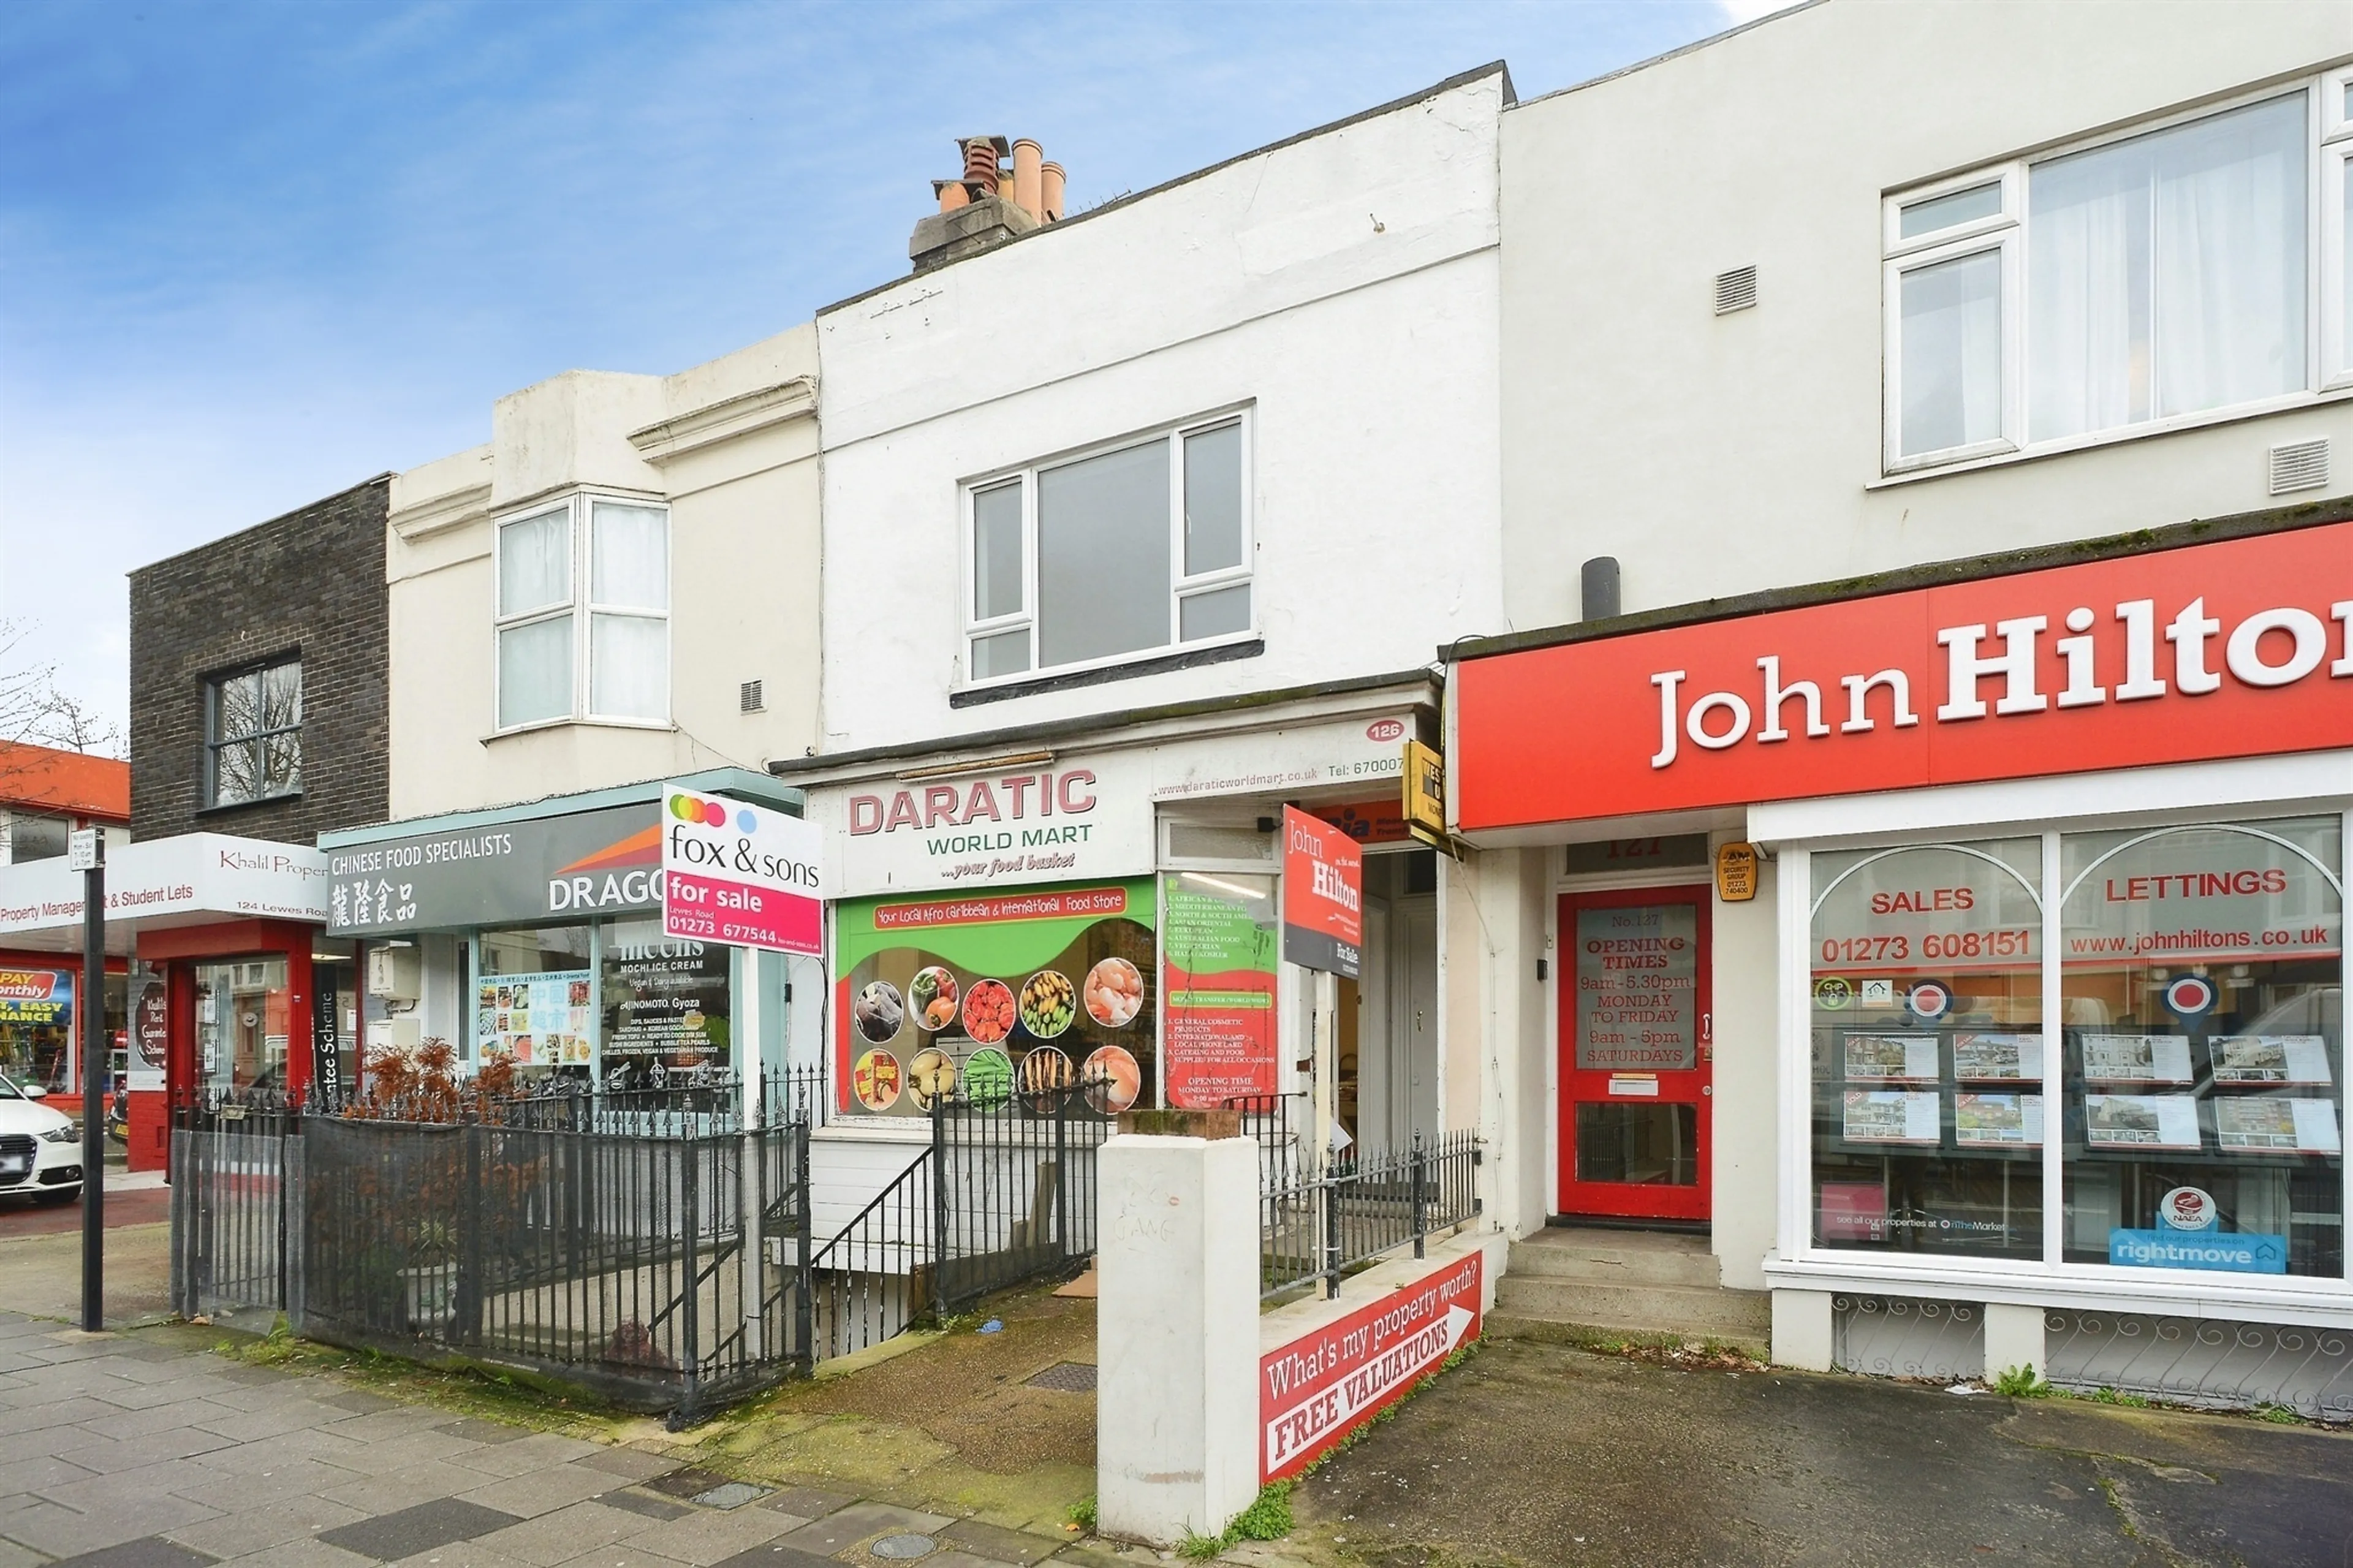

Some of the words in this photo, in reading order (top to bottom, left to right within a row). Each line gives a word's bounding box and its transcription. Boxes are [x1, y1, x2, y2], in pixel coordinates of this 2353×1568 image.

[1651, 656, 1919, 769] John
[1371, 724, 1400, 739] 126
[1328, 765, 1350, 777] Tel:
[1354, 757, 1404, 775] 670007
[849, 769, 1097, 836] DARATIC
[927, 832, 1012, 856] WORLD
[1022, 824, 1093, 848] MART
[1289, 819, 1323, 858] John
[220, 850, 268, 870] Khalil
[274, 855, 328, 881] Proper
[332, 851, 382, 876] CHINESE
[386, 846, 422, 869] FOOD
[426, 833, 512, 864] SPECIALISTS
[669, 825, 727, 868] fox
[735, 838, 757, 874] &
[763, 855, 819, 888] sons
[987, 854, 1023, 877] food
[1026, 852, 1076, 871] basket
[670, 876, 709, 904] for
[716, 888, 763, 912] sale
[1312, 860, 1358, 912] Hilton
[2106, 869, 2286, 902] LETTINGS
[1, 905, 39, 923] Property
[111, 894, 119, 907] &
[122, 888, 164, 906] Student
[168, 884, 193, 900] Lets
[237, 901, 257, 910] 124
[263, 904, 302, 915] Lewes
[306, 907, 328, 917] Roa
[669, 906, 692, 917] Lewes
[695, 909, 714, 918] Road
[877, 911, 898, 924] Your
[900, 908, 922, 923] Local
[924, 909, 943, 923] Afro
[946, 903, 990, 919] Caribbean
[993, 906, 999, 917] &
[1001, 898, 1061, 915] International
[1066, 895, 1090, 911] Food
[1093, 895, 1122, 909] Store
[1871, 888, 1974, 914] SALES
[669, 916, 715, 934] 01273
[723, 923, 776, 944] 677544
[1586, 937, 1685, 954] OPENING
[1822, 936, 1909, 963] 01273
[1922, 930, 2029, 959] 608151
[620, 964, 650, 974] MOCHI
[653, 962, 667, 972] ICE
[670, 960, 703, 971] CREAM
[1603, 955, 1668, 970] TIMES
[0, 973, 34, 984] PAY
[0, 985, 47, 998] onthly
[1597, 994, 1673, 1008] MONDAY
[20, 1002, 63, 1012] EASY
[672, 998, 700, 1010] Gyoza
[0, 1012, 53, 1022] NANCE
[1591, 1012, 1614, 1023] TO
[1619, 1010, 1680, 1023] FRIDAY
[1590, 1031, 1626, 1043] 9am
[1641, 1029, 1681, 1046] 5pm
[1587, 1049, 1683, 1062] SATURDAYS
[1854, 1215, 1863, 1224] all
[1881, 1218, 1927, 1232] properties
[2183, 1235, 2232, 1246] properties
[2117, 1241, 2253, 1263] rightmove
[1267, 1337, 1337, 1401] What's
[1343, 1325, 1370, 1361] my
[1373, 1289, 1437, 1351] property
[1440, 1260, 1477, 1303] worth?
[1275, 1388, 1338, 1461] FREE
[1344, 1318, 1448, 1411] VALUATIONS
